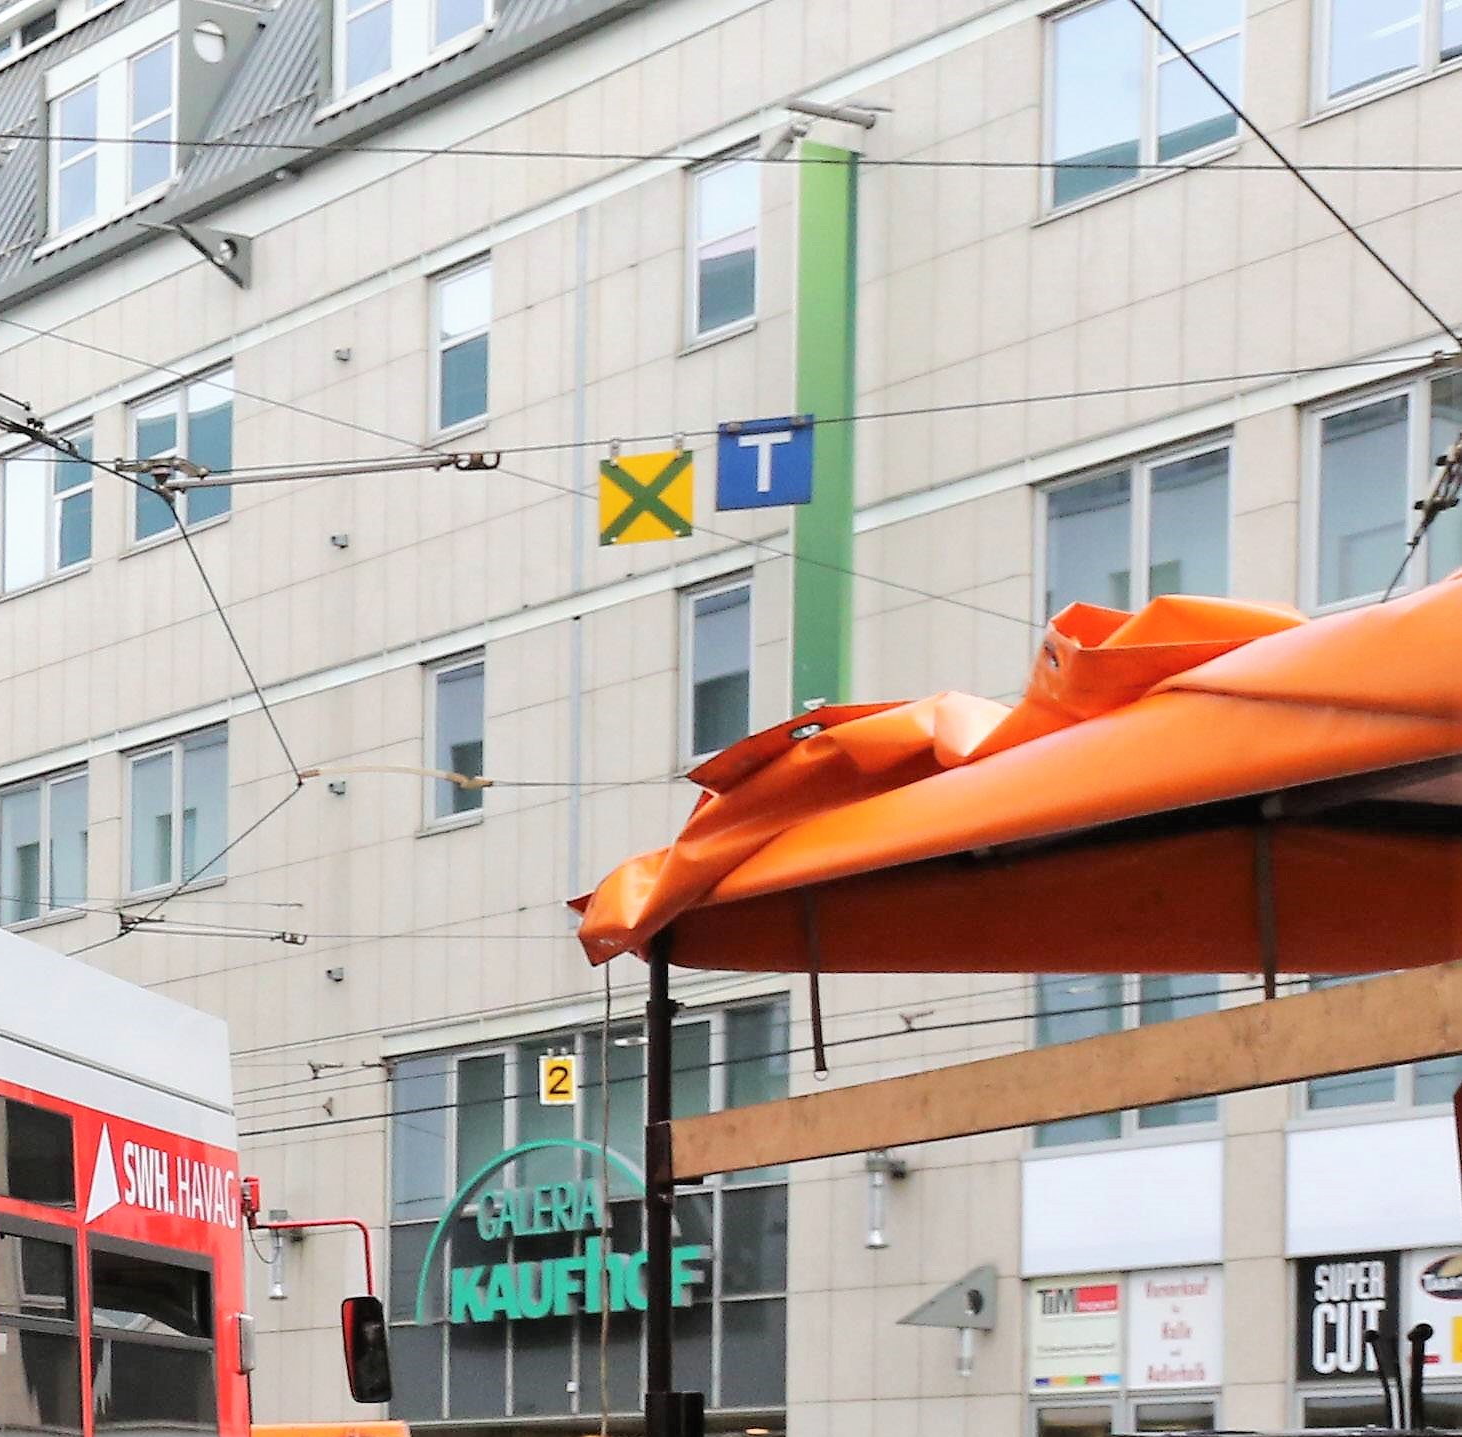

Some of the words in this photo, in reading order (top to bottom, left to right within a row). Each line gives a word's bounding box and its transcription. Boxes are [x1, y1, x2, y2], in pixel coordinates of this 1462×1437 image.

[738, 430, 792, 493] T
[548, 1066, 569, 1095] 2
[123, 1140, 175, 1214] SWH.
[176, 1155, 237, 1229] HAVAG
[476, 1178, 604, 1242] GALERIA
[1314, 1261, 1386, 1303] SUPER
[1312, 1300, 1387, 1374] CUT
